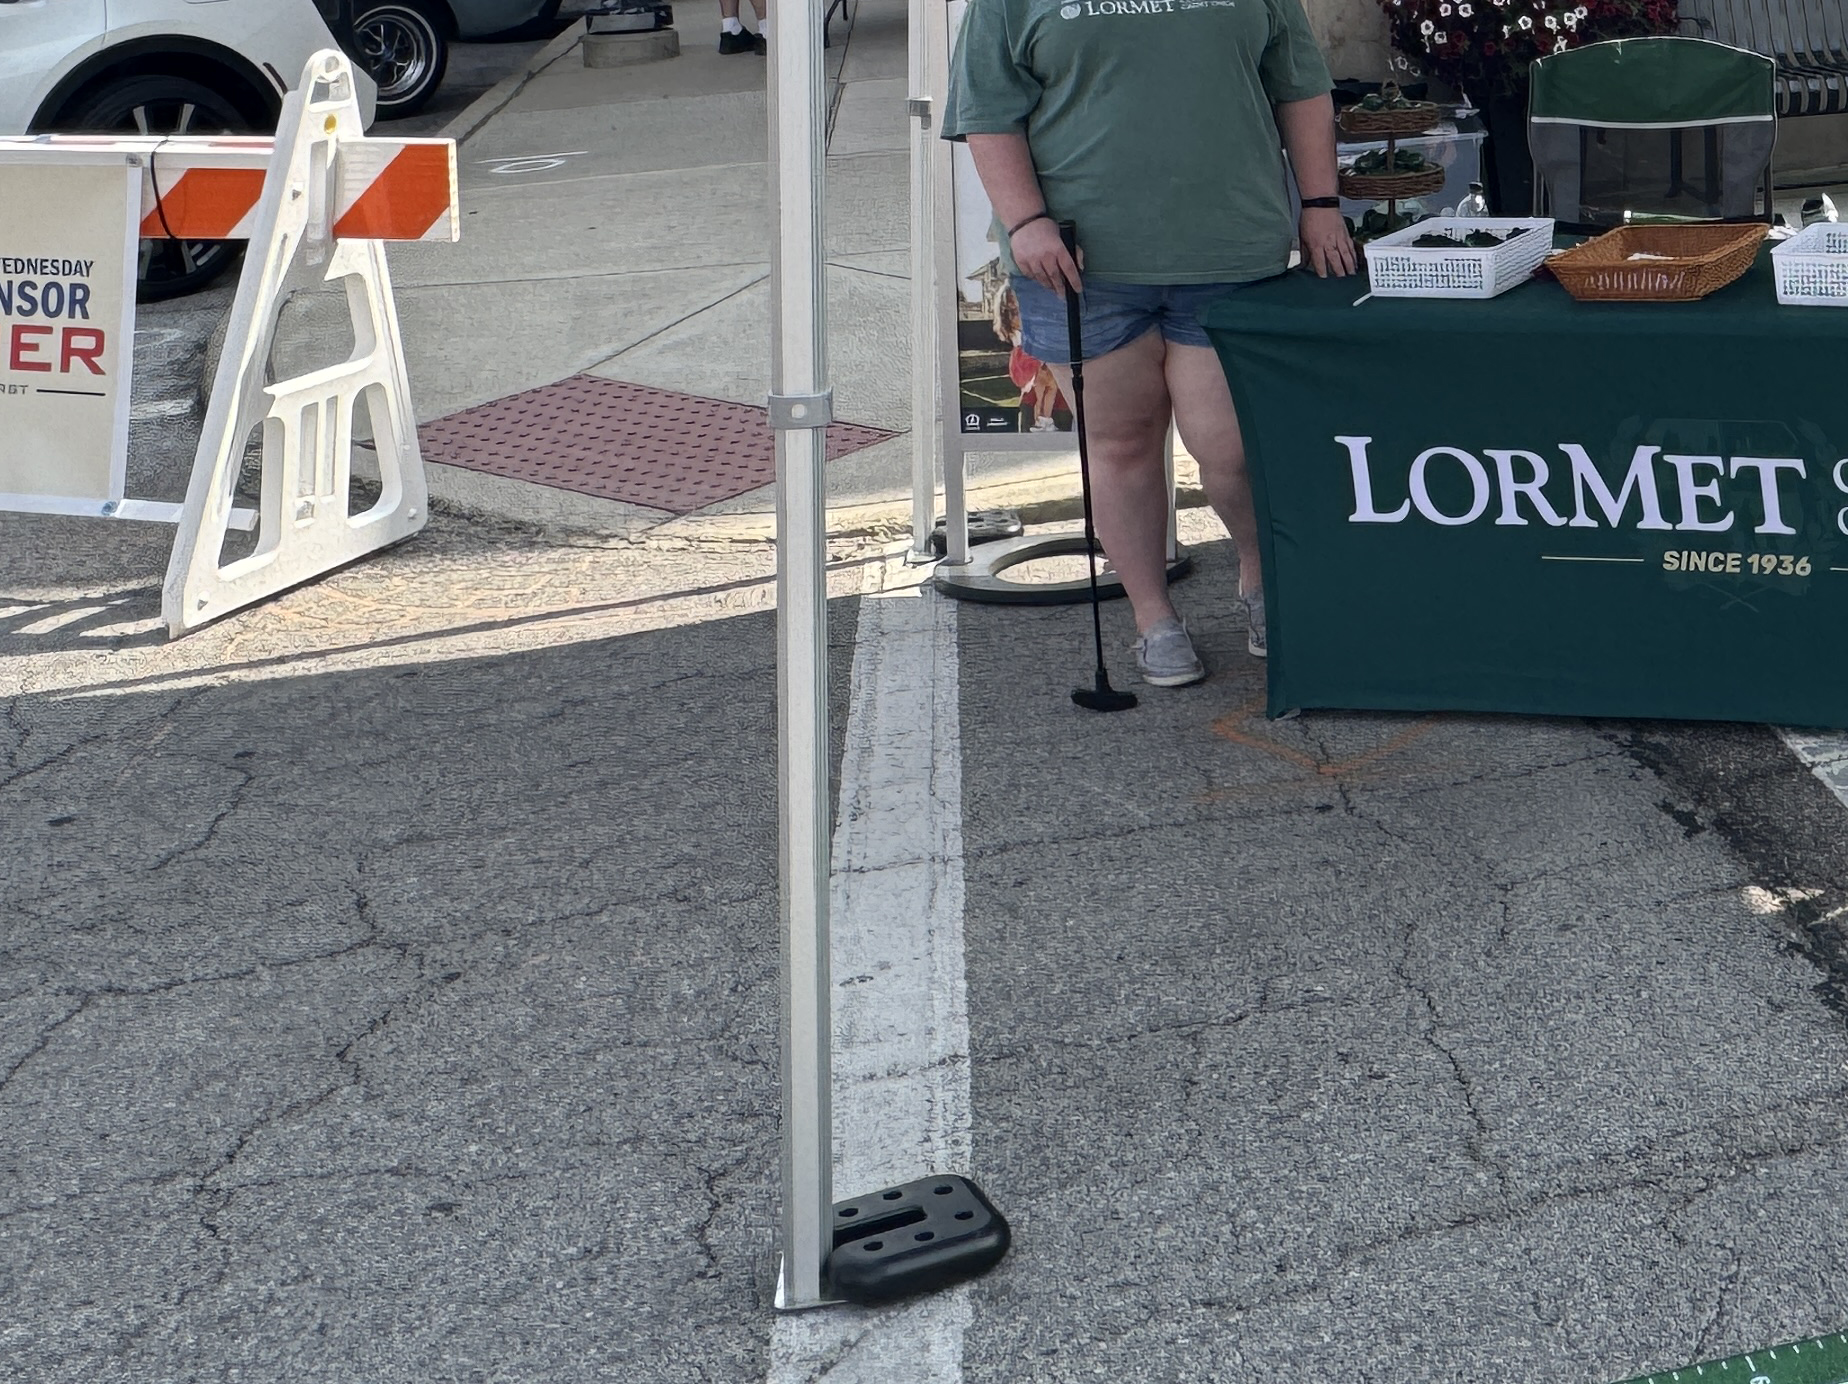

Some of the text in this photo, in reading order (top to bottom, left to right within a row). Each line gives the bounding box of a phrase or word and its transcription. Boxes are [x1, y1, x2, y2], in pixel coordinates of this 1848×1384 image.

[0, 257, 94, 277] EDNESDAY
[1662, 551, 1812, 576] SINCE 1936
